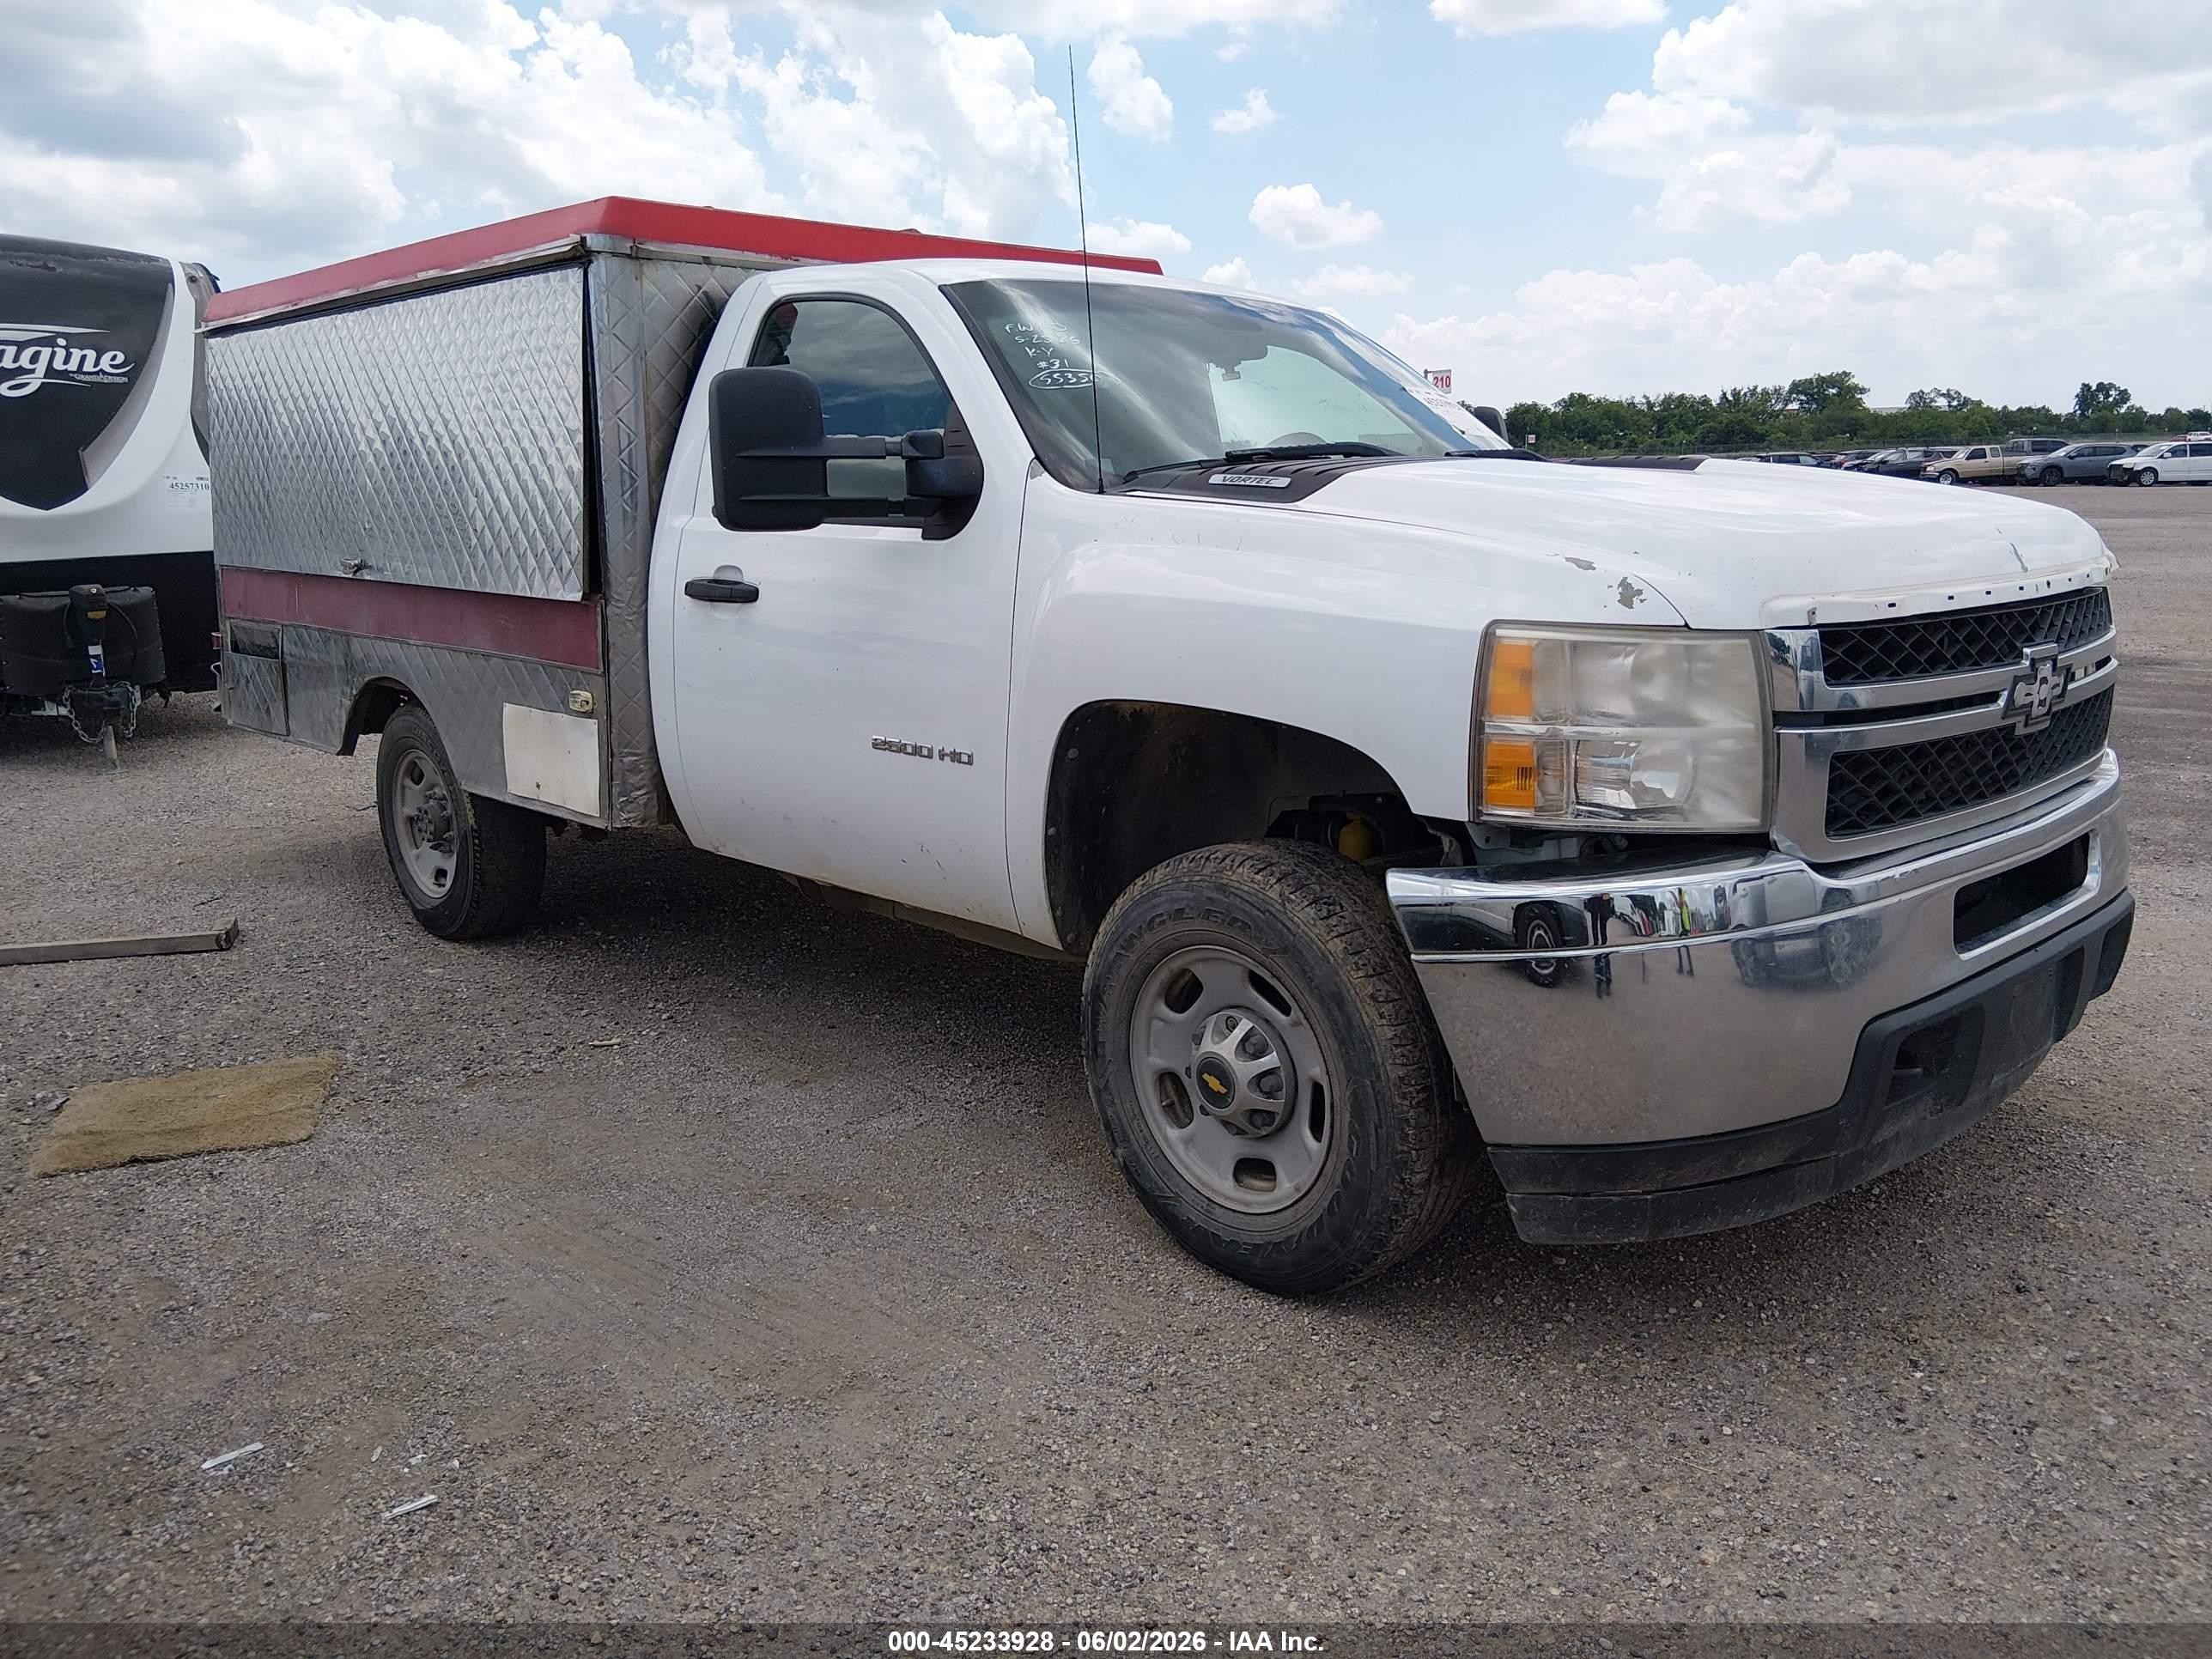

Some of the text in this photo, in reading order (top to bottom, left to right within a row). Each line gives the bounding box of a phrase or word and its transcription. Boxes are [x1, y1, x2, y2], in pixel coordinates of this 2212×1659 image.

[1432, 375, 1451, 388] 210
[1222, 476, 1279, 485] VORTEC
[169, 482, 210, 491] 45257310
[871, 735, 975, 765] 2500 HD
